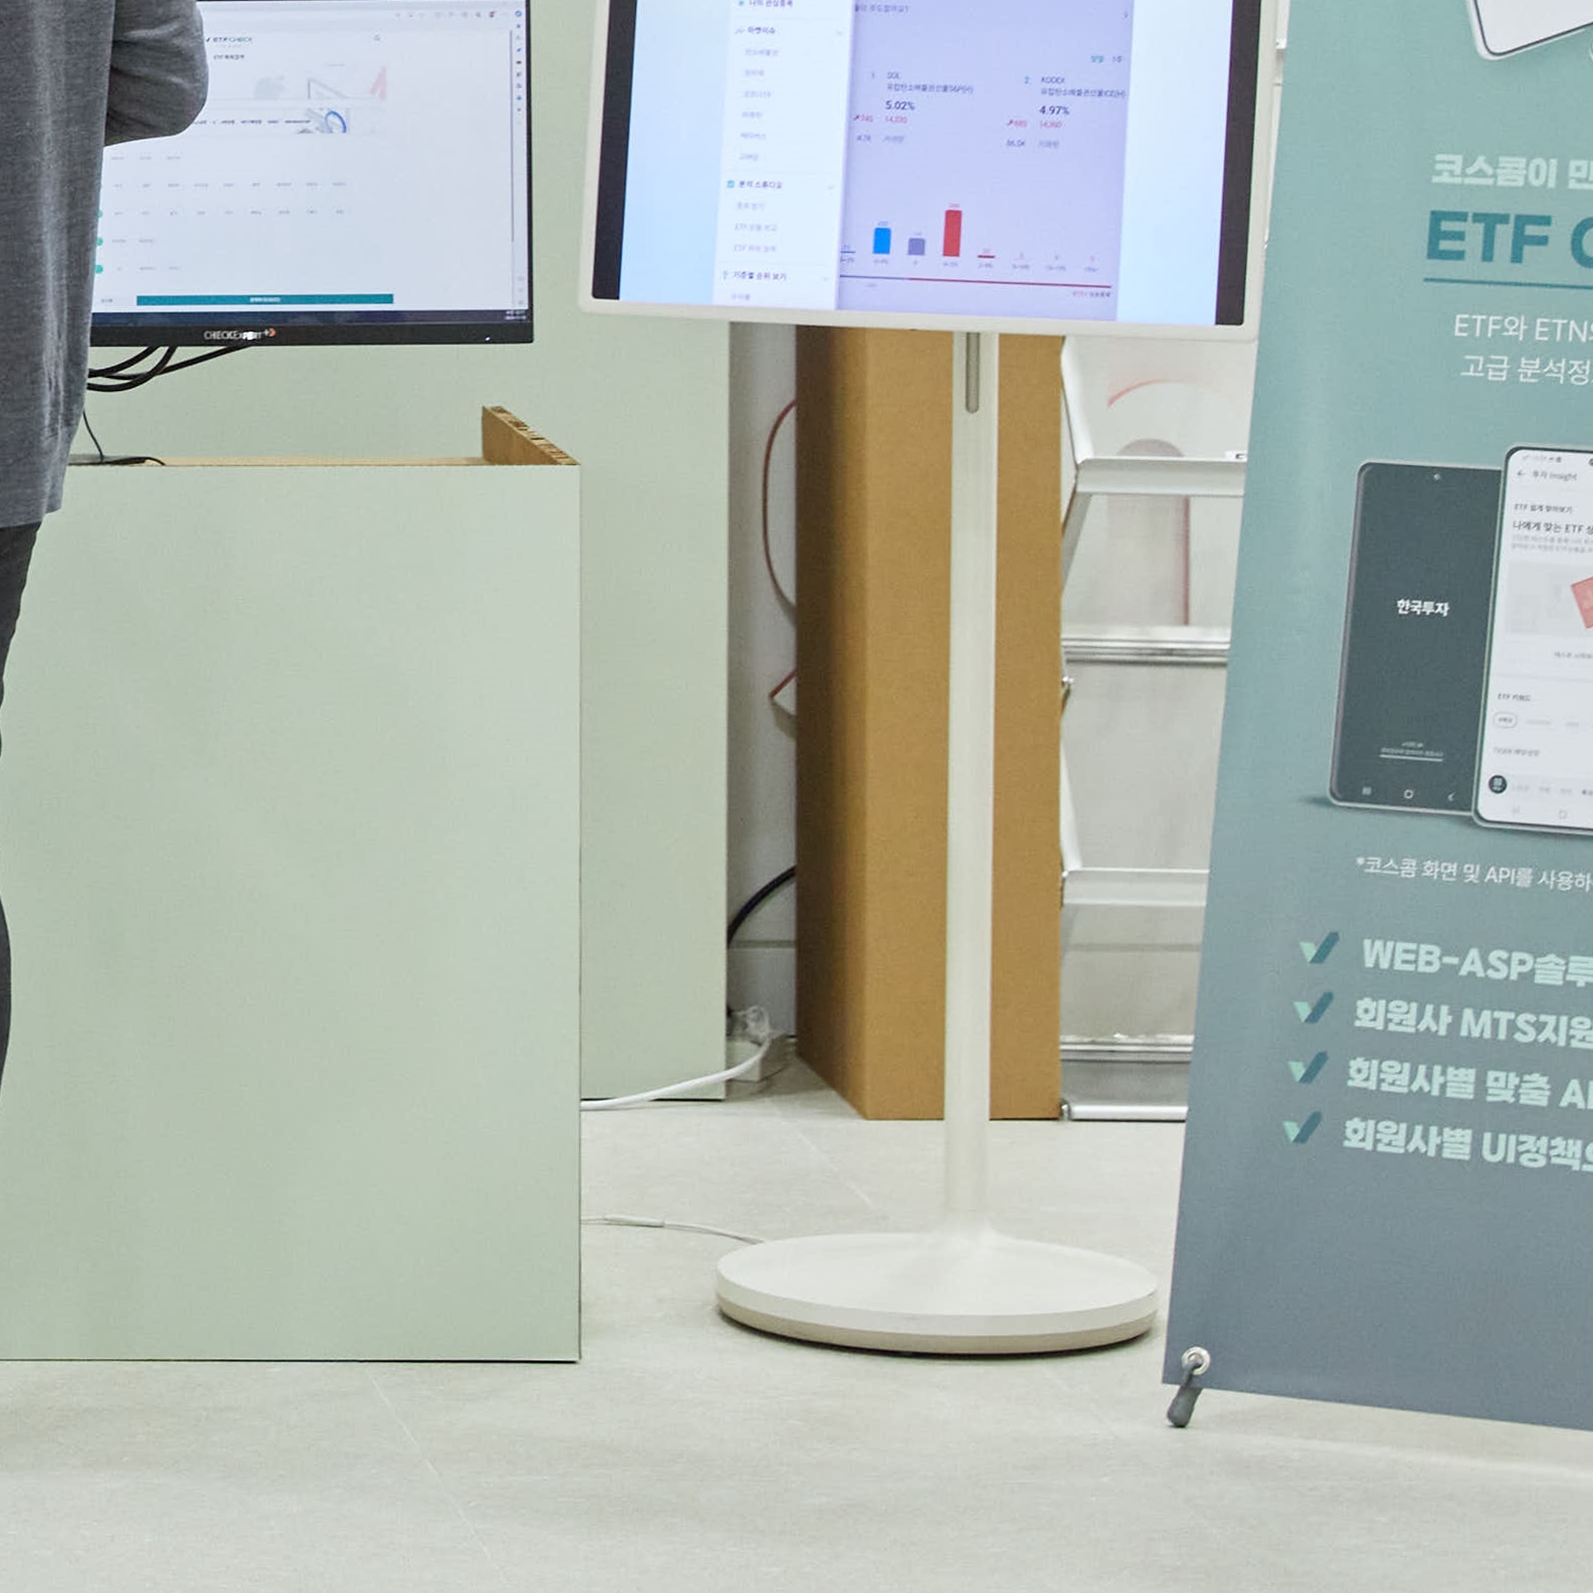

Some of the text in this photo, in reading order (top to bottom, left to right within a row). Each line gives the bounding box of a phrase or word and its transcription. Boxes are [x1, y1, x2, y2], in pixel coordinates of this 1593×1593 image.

[885, 100, 915, 111] 5.02%
[1039, 105, 1070, 116] 4.97%
[1425, 209, 1553, 265] ETF
[1453, 313, 1528, 342] ETF와
[1460, 354, 1593, 386] 고급 분석정
[1512, 520, 1542, 532] 나에게
[1564, 523, 1585, 534] ETF
[1396, 598, 1451, 618] 한국투자
[1421, 859, 1459, 882] 화면
[1463, 864, 1482, 884] 및
[1484, 867, 1534, 889] API를
[1354, 997, 1453, 1036] 회원사
[1346, 1056, 1477, 1100] 회원사별
[1485, 1070, 1552, 1107] 맞춤
[1343, 1116, 1473, 1161] 회원사별
